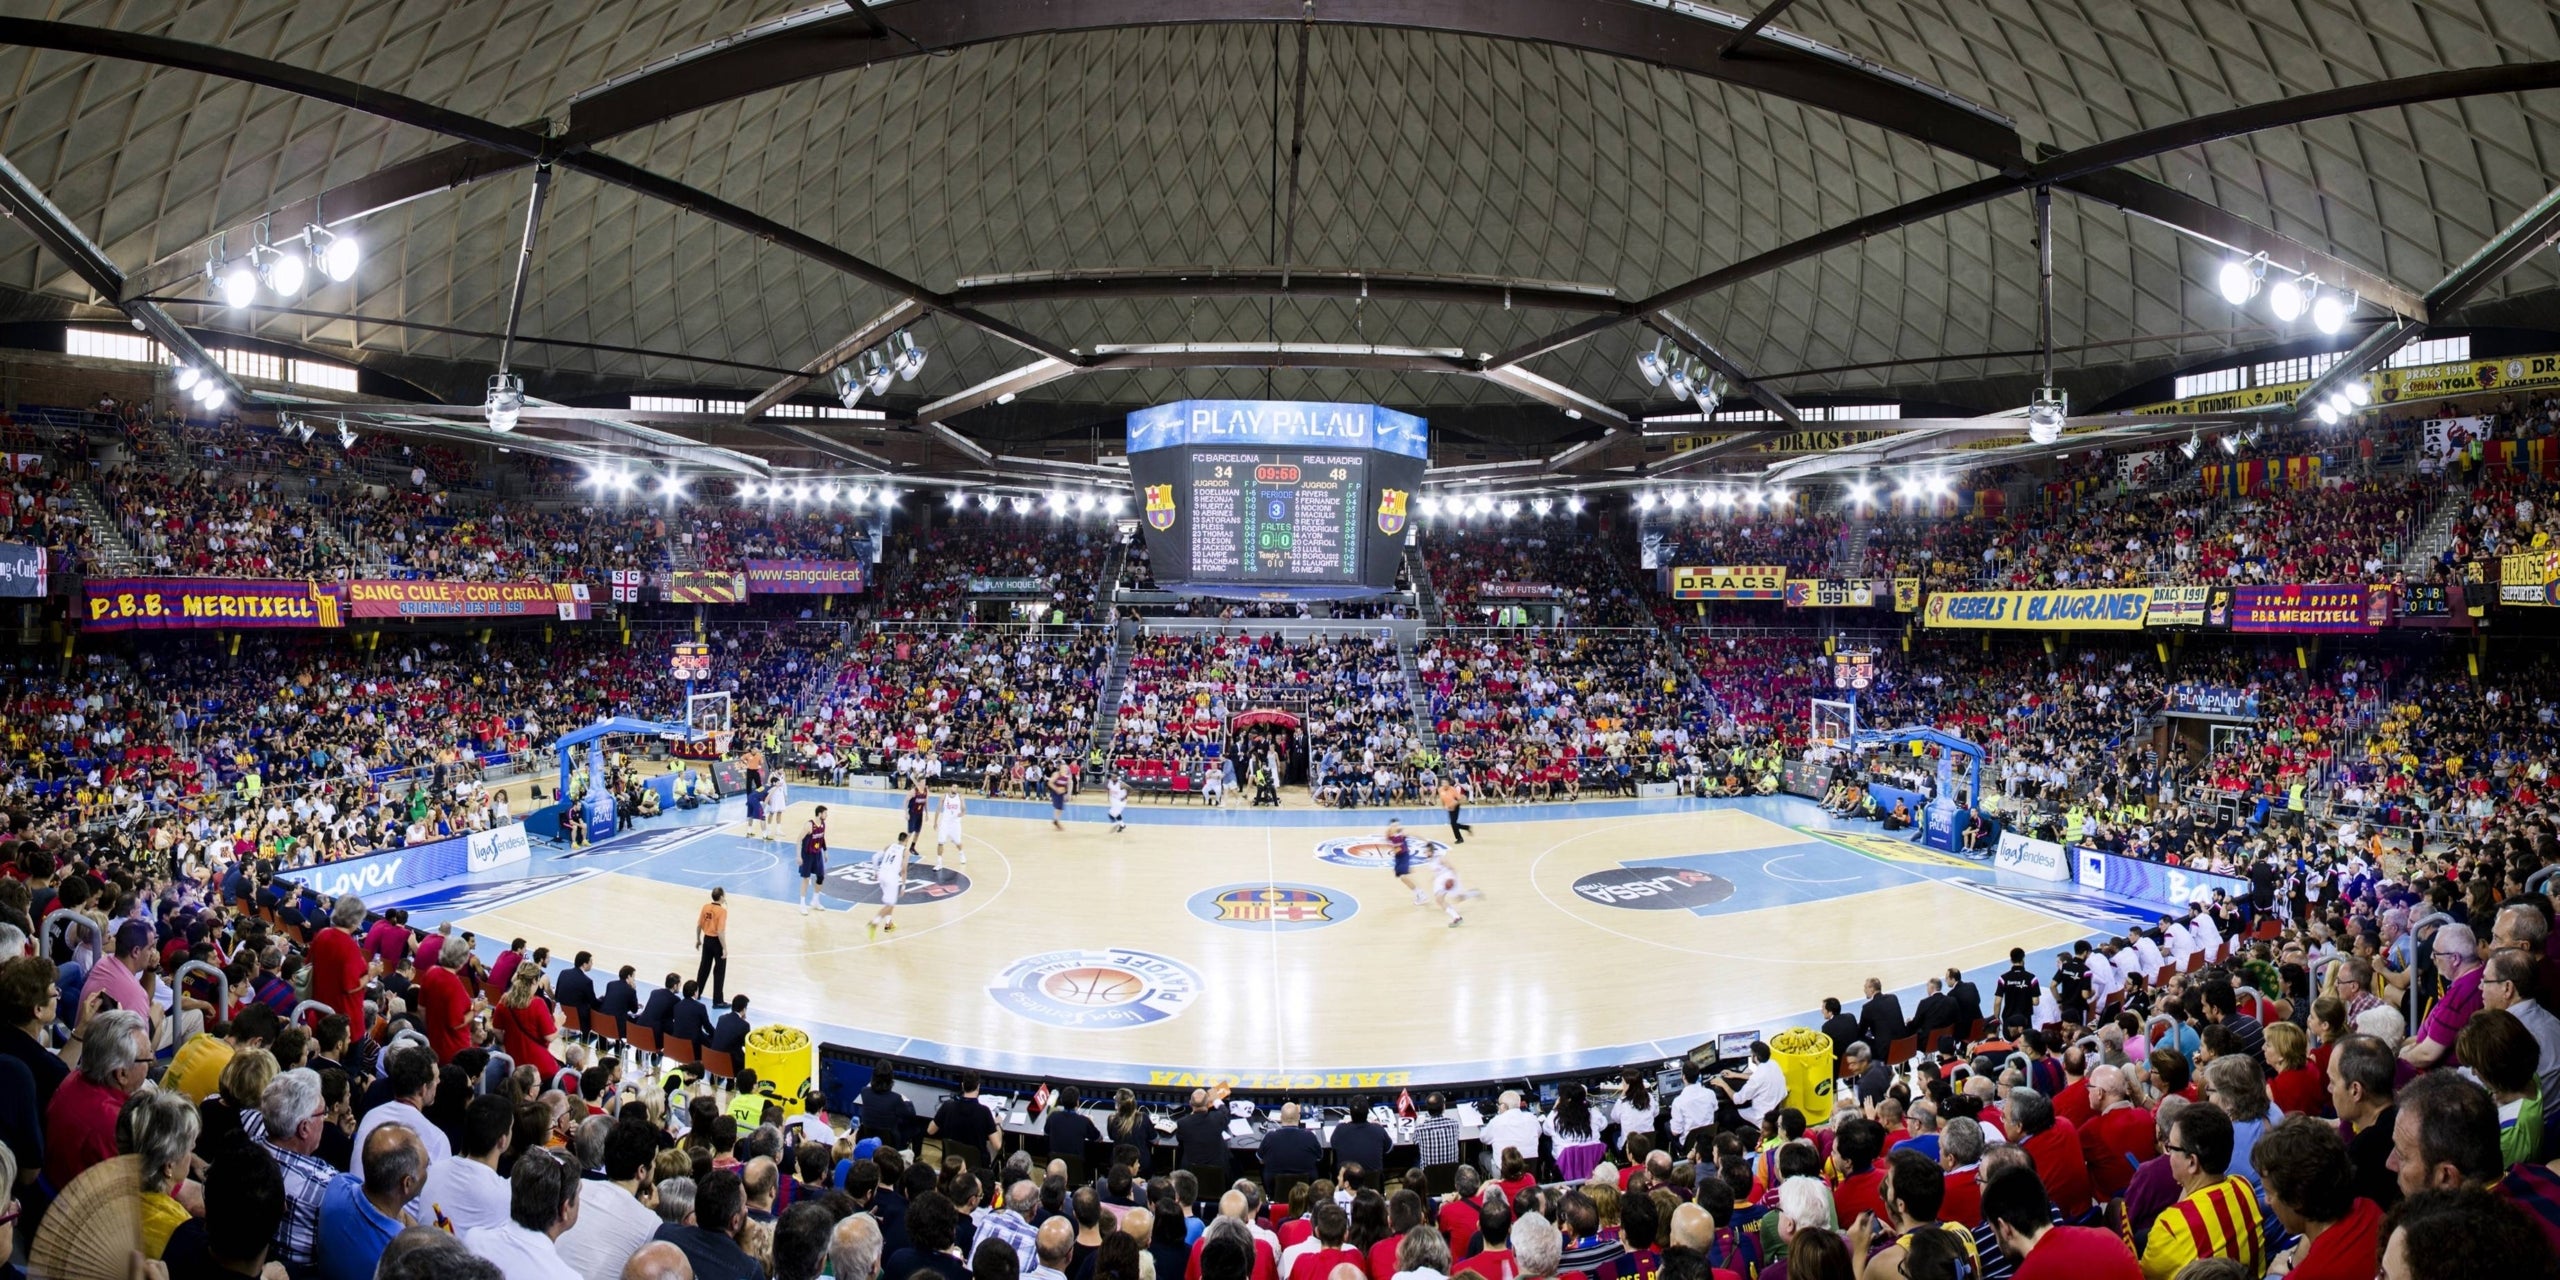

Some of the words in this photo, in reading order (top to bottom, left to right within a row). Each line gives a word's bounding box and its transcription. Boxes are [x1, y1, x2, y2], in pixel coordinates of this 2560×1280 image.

[2406, 366, 2441, 380] DRACS
[2446, 364, 2470, 376] 1991
[1192, 409, 1262, 435] PLAY
[1274, 411, 1364, 438] PALAU
[1779, 431, 1839, 451] DRACS
[1192, 454, 1204, 463] FC
[1206, 454, 1259, 463] BARCELONA
[1303, 455, 1326, 465] REAL
[1327, 456, 1362, 465] MADRID
[1214, 465, 1233, 478] 34
[1329, 468, 1347, 480] 48
[1301, 481, 1337, 489] JUGADOR
[2203, 461, 2250, 497] VIU
[1260, 490, 1294, 499] PERIODE
[1271, 504, 1281, 516] 3
[1261, 522, 1292, 531] FALTES
[1261, 535, 1271, 546] 0
[1281, 535, 1290, 546] 0
[2501, 553, 2544, 585] DRACS
[749, 567, 860, 586] www.sangcule.cat
[985, 581, 1004, 589] PLAY
[1006, 581, 1036, 589] HOQUEI
[1495, 585, 1514, 594] PLAY
[351, 584, 403, 600] SANG
[408, 583, 451, 601] CULÉ
[467, 586, 498, 601] COR
[502, 584, 553, 601] CATALÀ
[1817, 592, 1850, 604] 1991
[2153, 588, 2180, 601] DRACS
[2501, 586, 2544, 602] SUPPORTERS
[90, 594, 170, 620] P.B.B.
[182, 594, 313, 618] MERITXELL
[400, 602, 462, 614] ORIGINALS
[466, 601, 486, 613] DES
[489, 601, 502, 612] DE
[504, 601, 524, 612] 1991
[1947, 595, 2008, 621] REBELS
[2012, 595, 2020, 620] I
[2027, 594, 2147, 621] BLAUGRANES
[2278, 609, 2359, 623] MERITXELL
[2180, 693, 2206, 707] PLAY
[2208, 695, 2241, 708] PALAU
[886, 853, 896, 864] 14
[315, 857, 402, 899] Lover
[1583, 875, 1693, 903] LASSA
[1113, 955, 1190, 1003] PLAYOFF
[1149, 1070, 1413, 1088] BARCELONA
[733, 1109, 750, 1121] TV
[1401, 1118, 1413, 1127] 2
